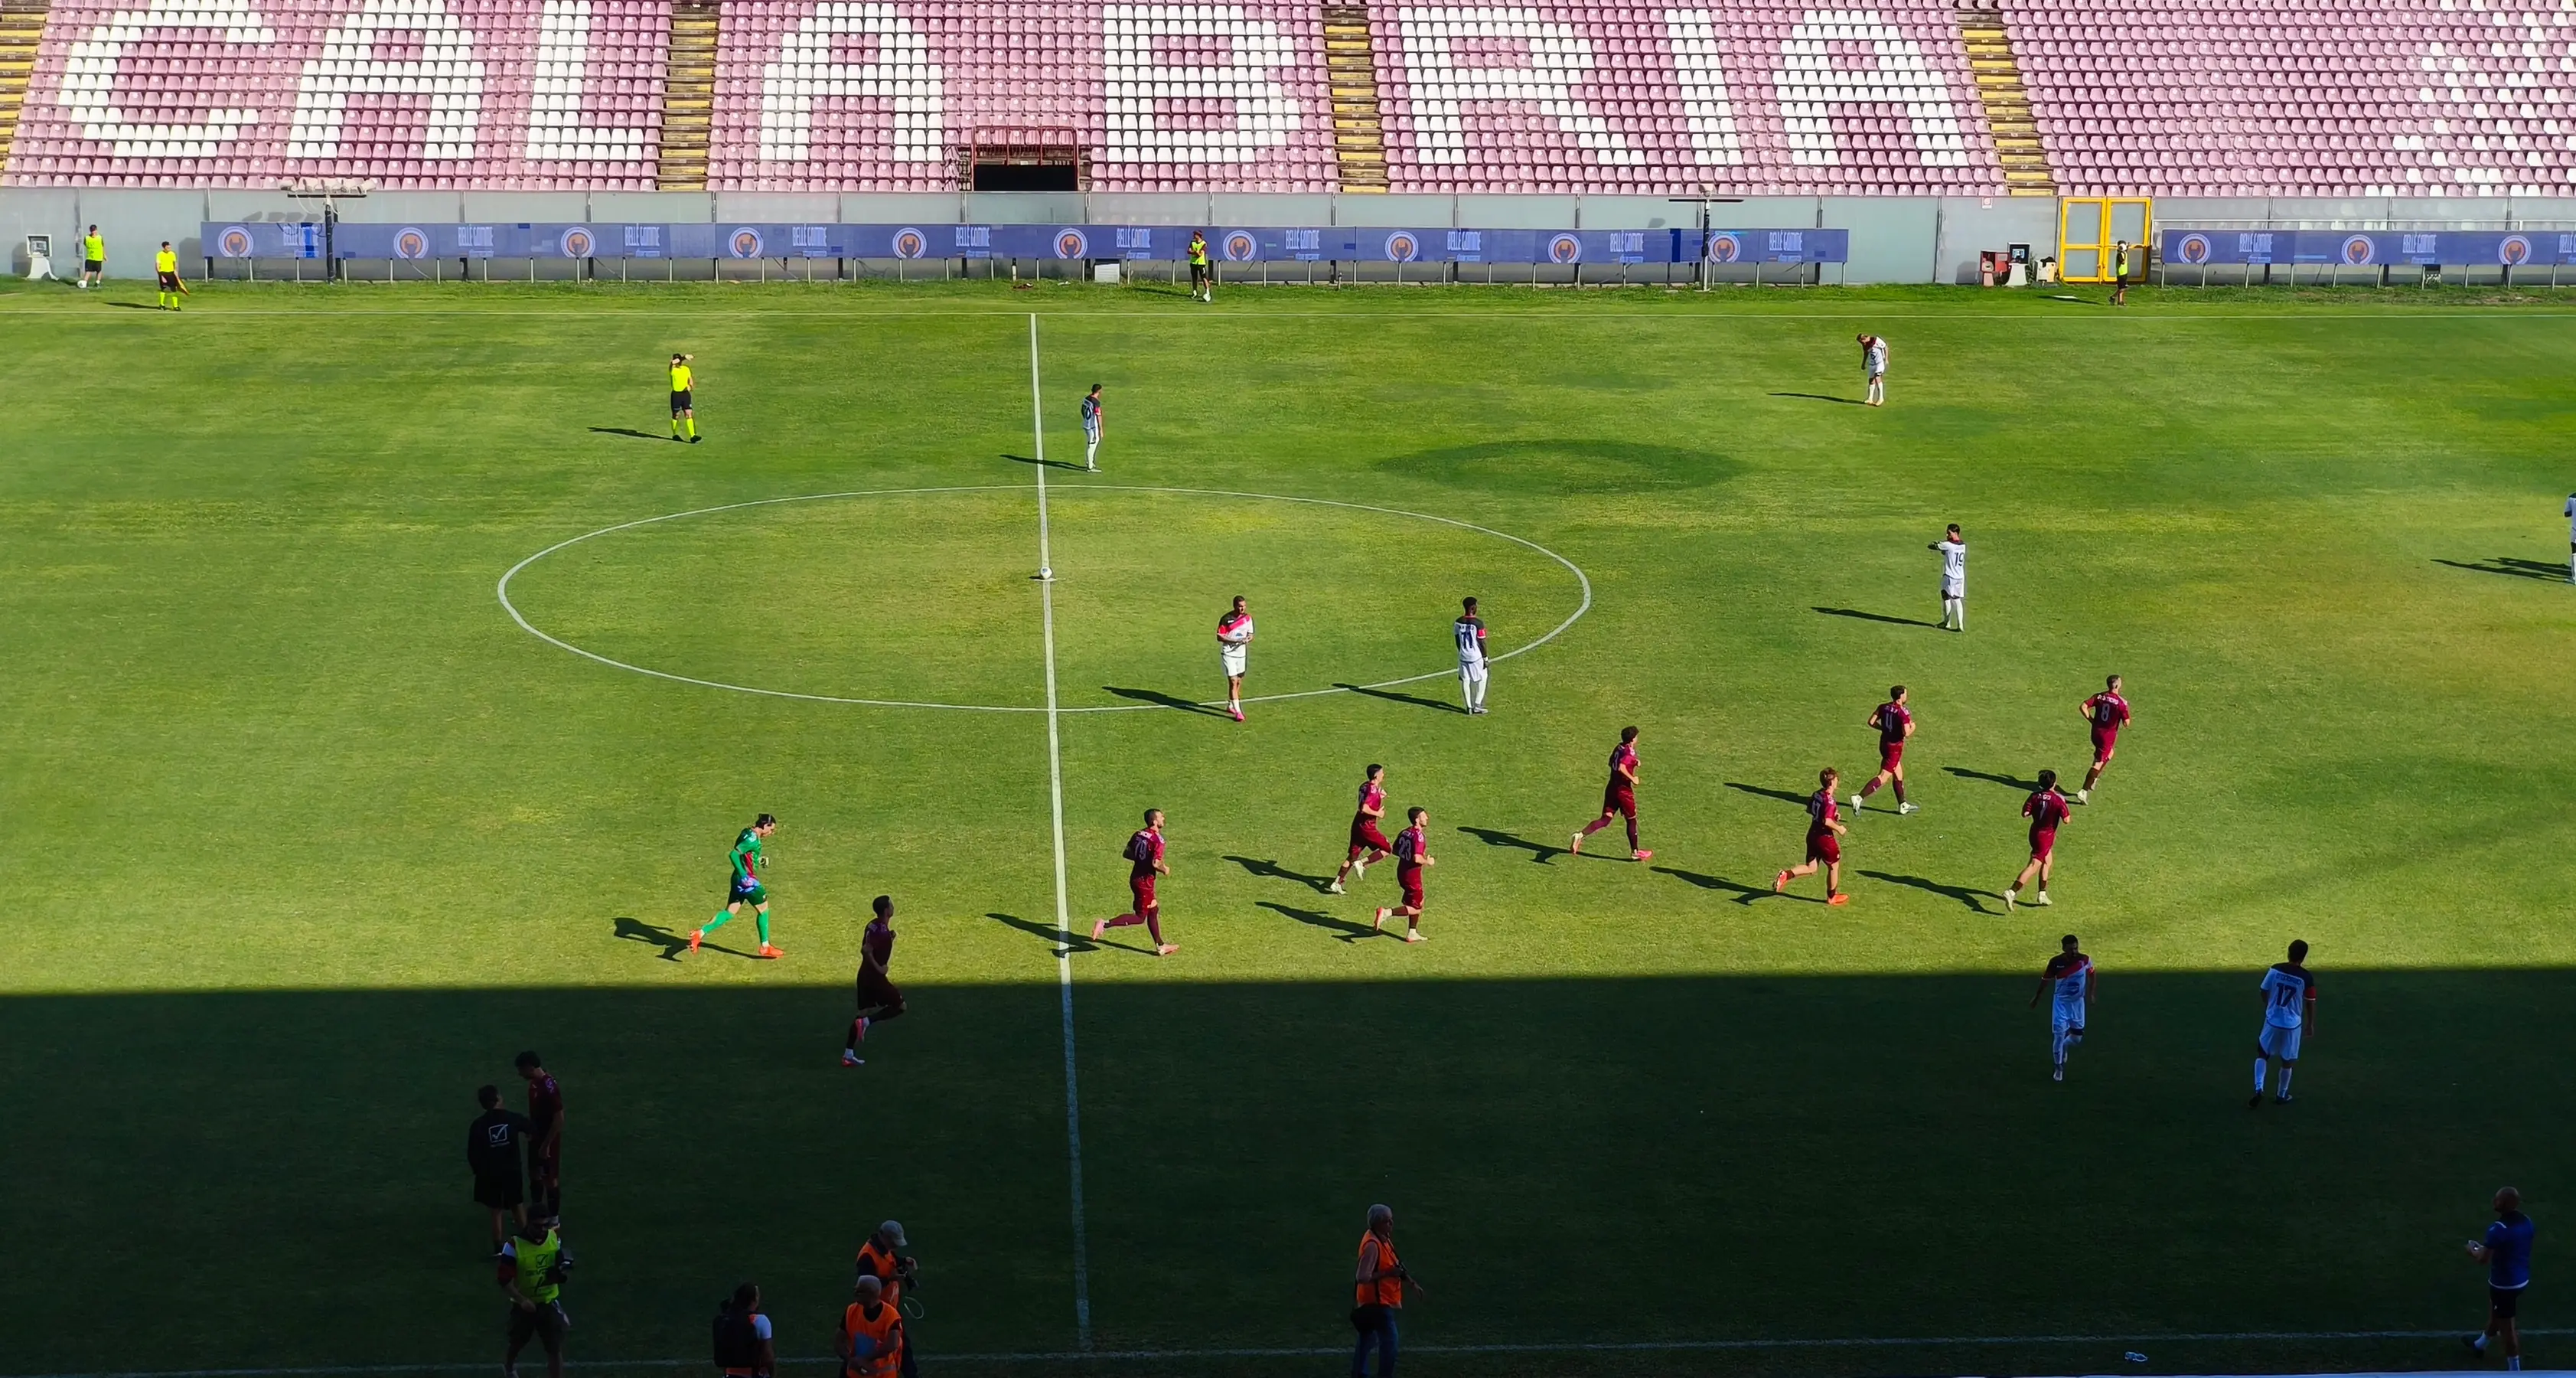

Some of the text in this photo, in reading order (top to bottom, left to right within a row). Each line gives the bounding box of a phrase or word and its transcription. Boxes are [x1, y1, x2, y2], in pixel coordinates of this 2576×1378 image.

[57, 0, 1970, 167] CALABRIA
[1954, 552, 1965, 567] 19
[2101, 703, 2110, 722] 8
[1885, 713, 1893, 733] 4
[2276, 982, 2297, 1007] 17
